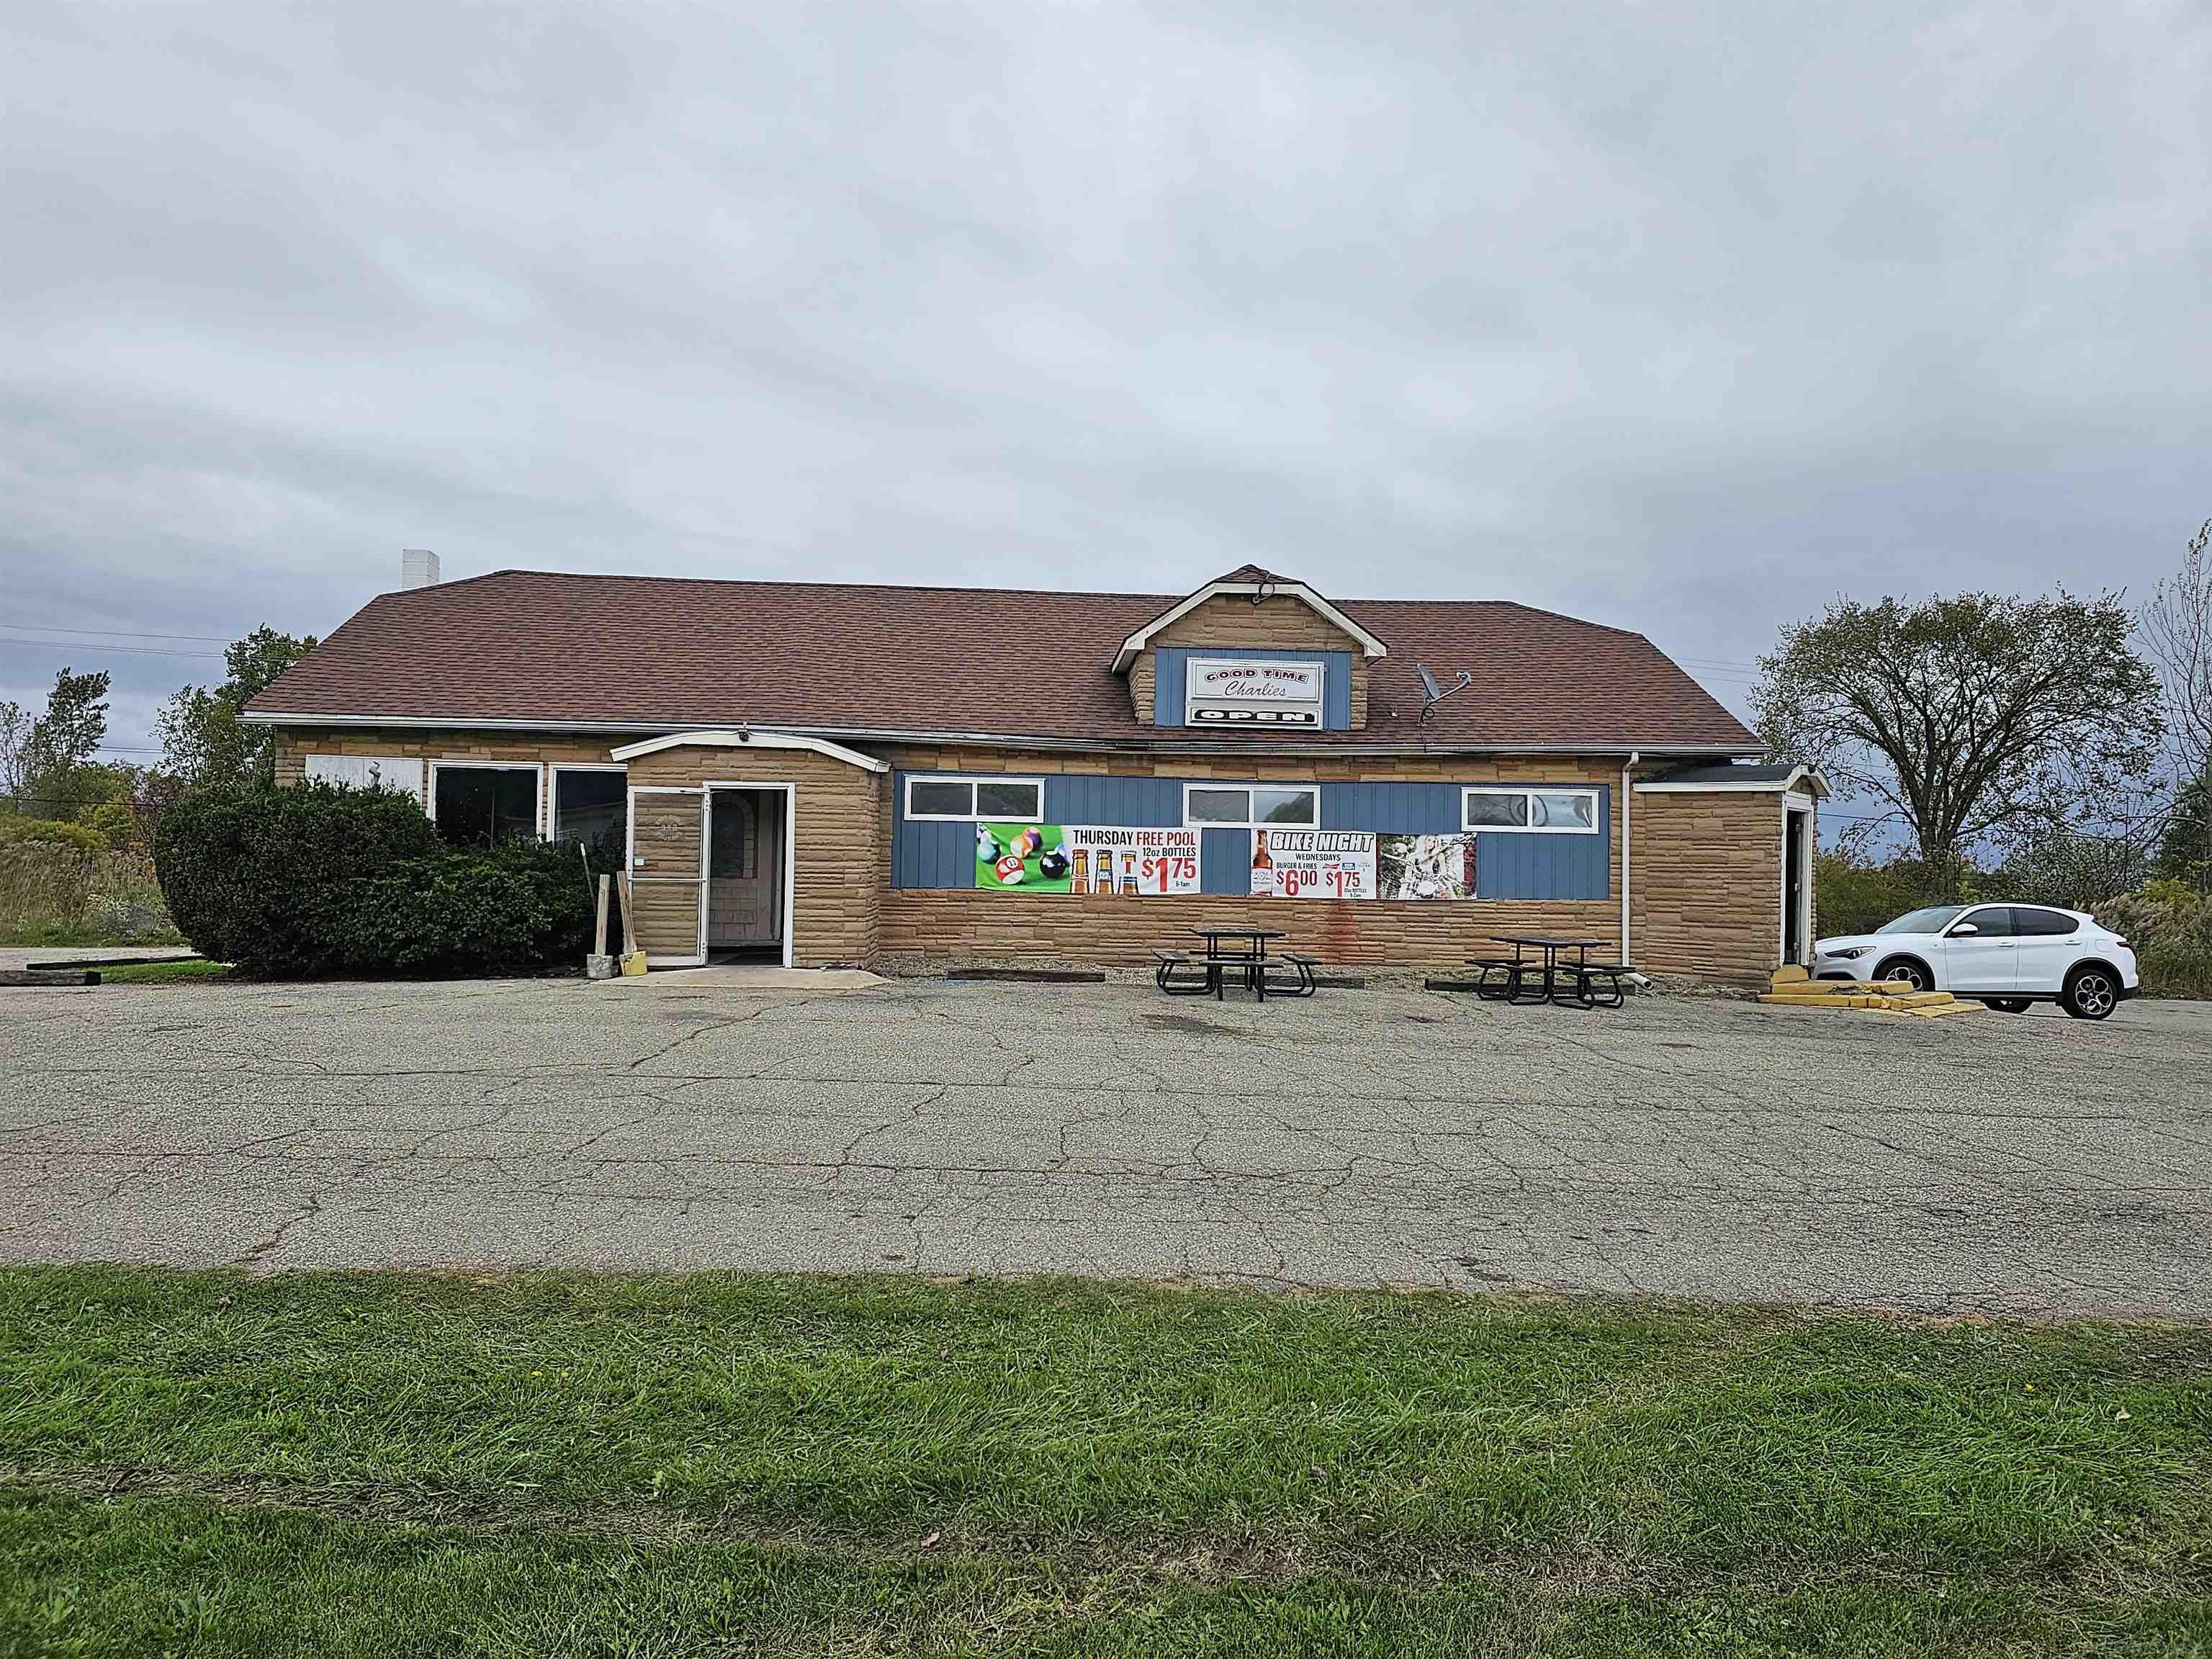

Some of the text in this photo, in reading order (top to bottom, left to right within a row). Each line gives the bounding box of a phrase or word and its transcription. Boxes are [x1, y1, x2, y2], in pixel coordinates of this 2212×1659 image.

[1205, 669, 1309, 684] GOOD TIME
[1224, 680, 1286, 696] Charlies
[1200, 711, 1305, 721] OPEN
[1074, 830, 1196, 846] THURSDAY FREE POOL
[1270, 832, 1374, 852] BIKE NIGHT
[1143, 848, 1196, 857] 12oz BOTTLES
